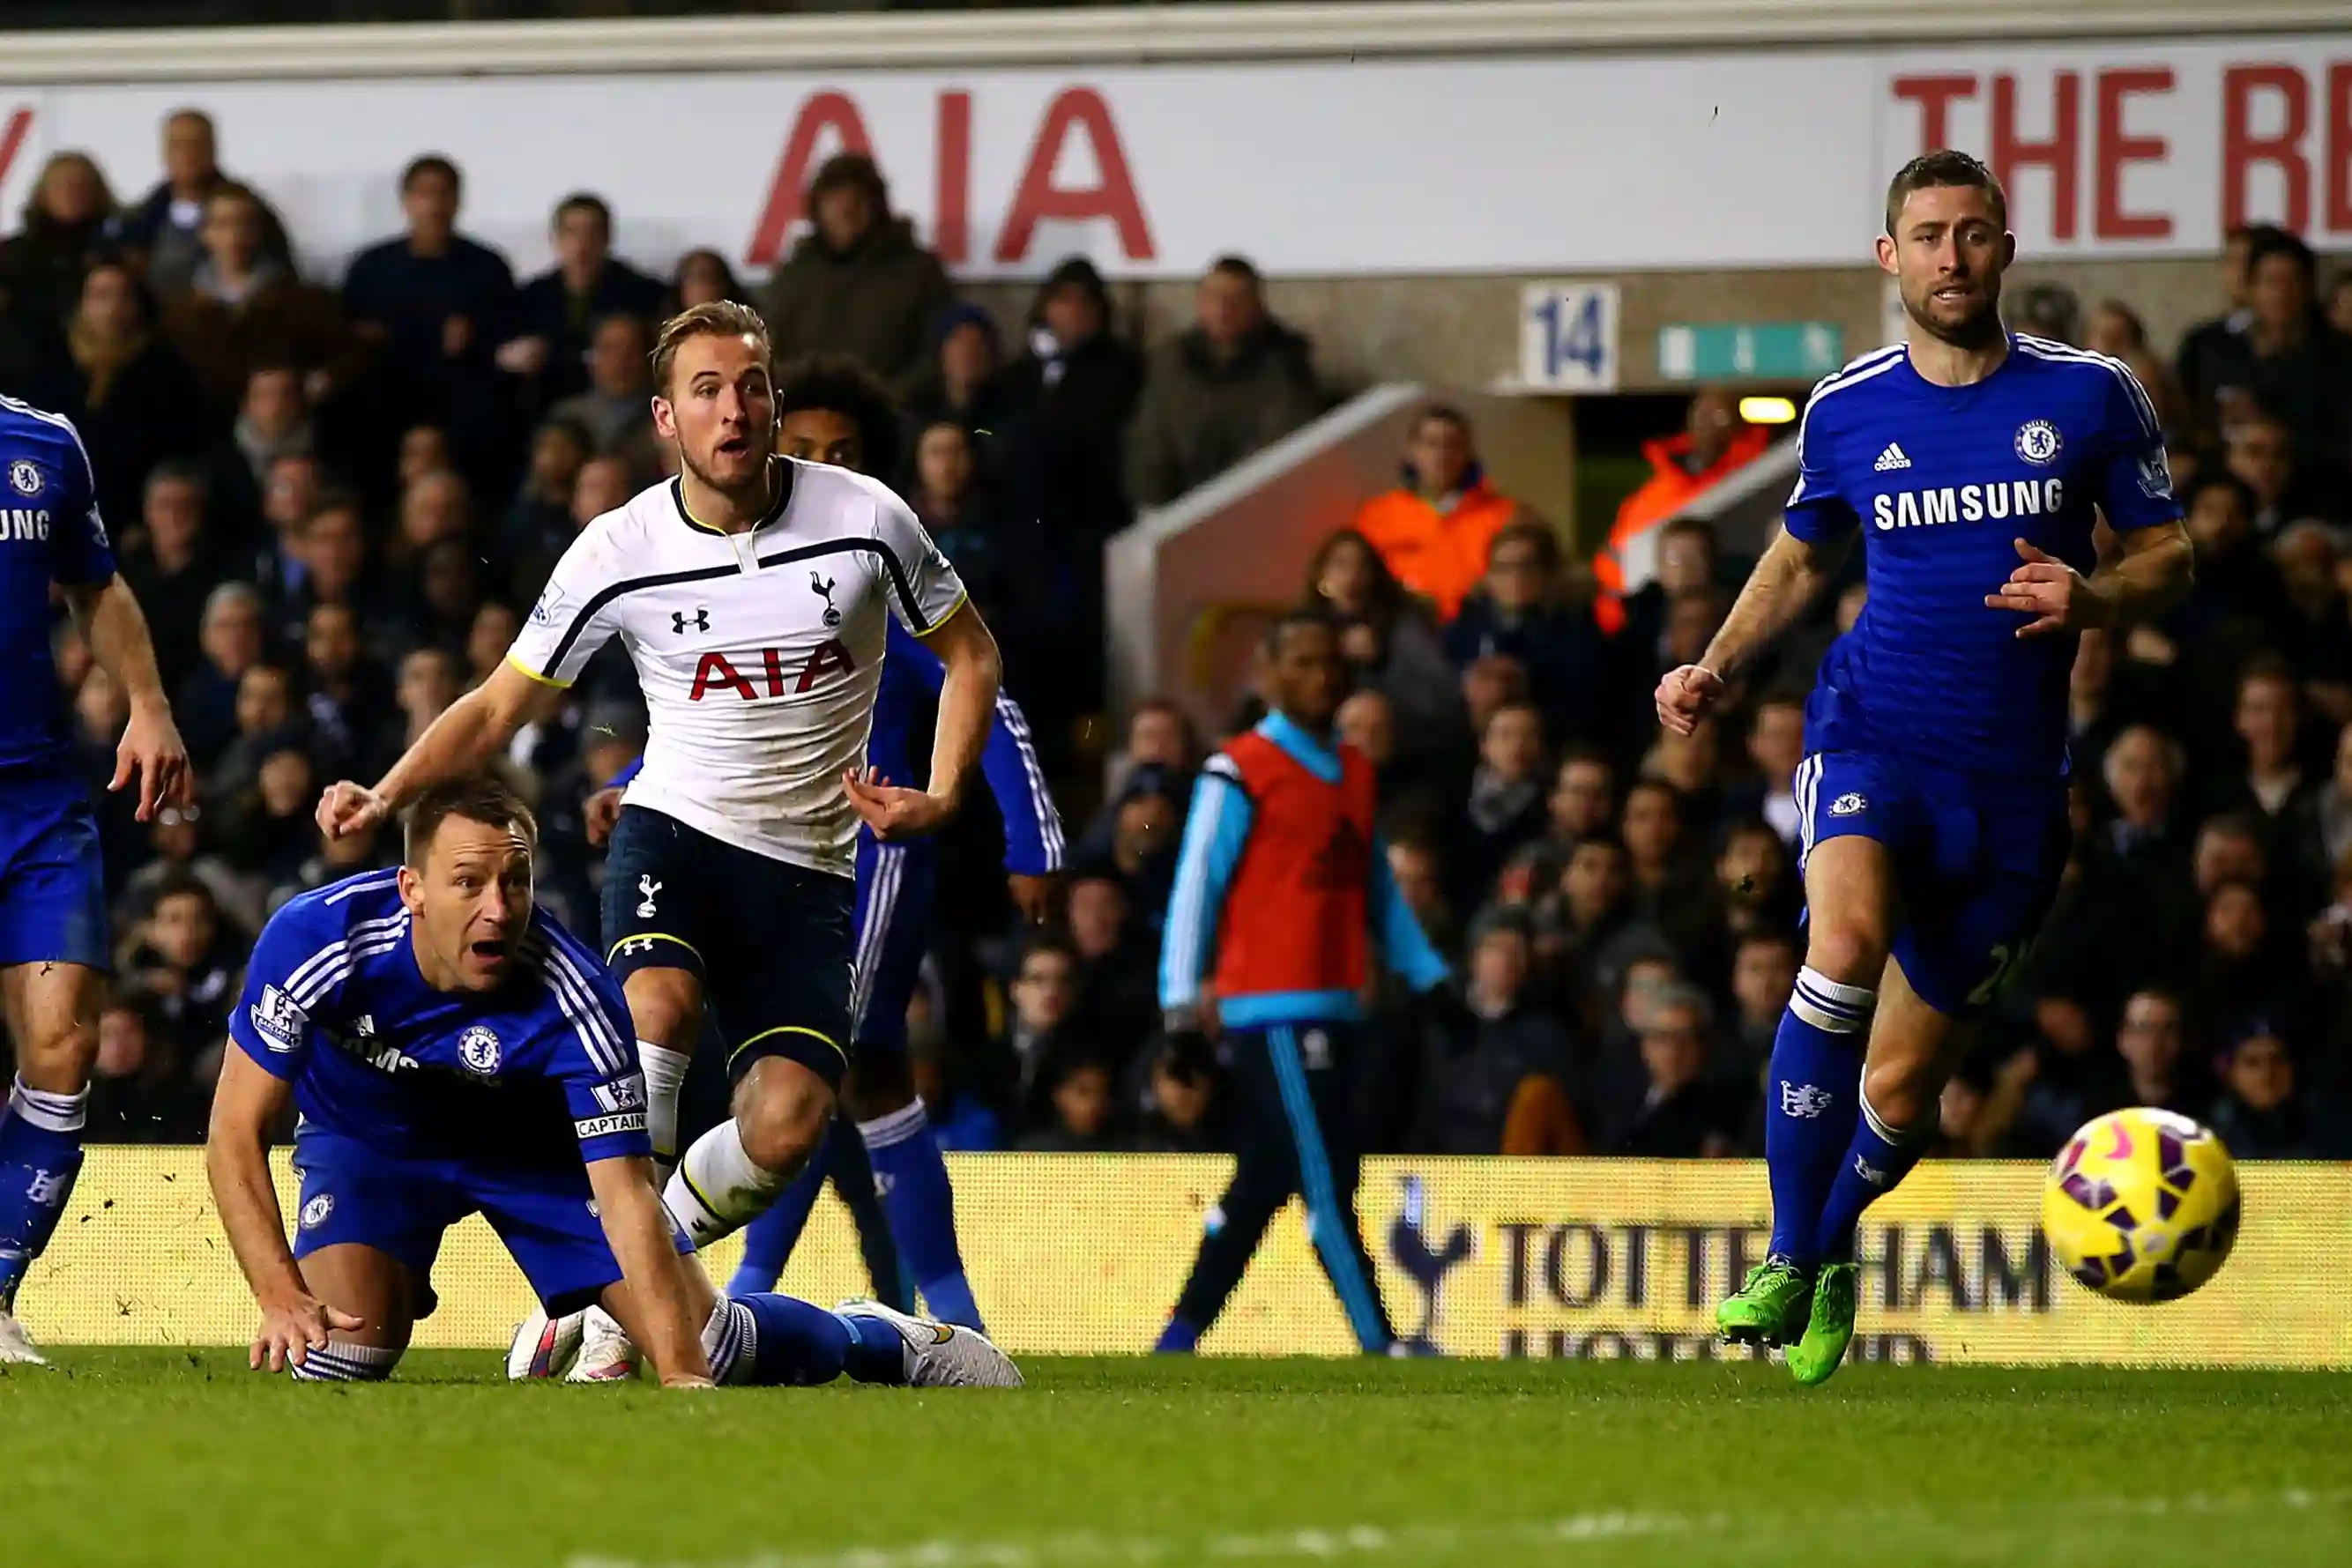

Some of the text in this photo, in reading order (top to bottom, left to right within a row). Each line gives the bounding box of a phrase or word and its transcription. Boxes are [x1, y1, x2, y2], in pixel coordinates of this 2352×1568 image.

[745, 86, 1156, 265] AIA
[1893, 65, 2175, 241] THE
[1532, 294, 1604, 377] 14
[1874, 457, 1911, 472] adidas
[1874, 478, 2063, 531] SAMSUNG
[688, 638, 856, 702] AIA
[578, 1114, 644, 1136] CAPTAIN
[1499, 1222, 2051, 1309] TOTTEHAM
